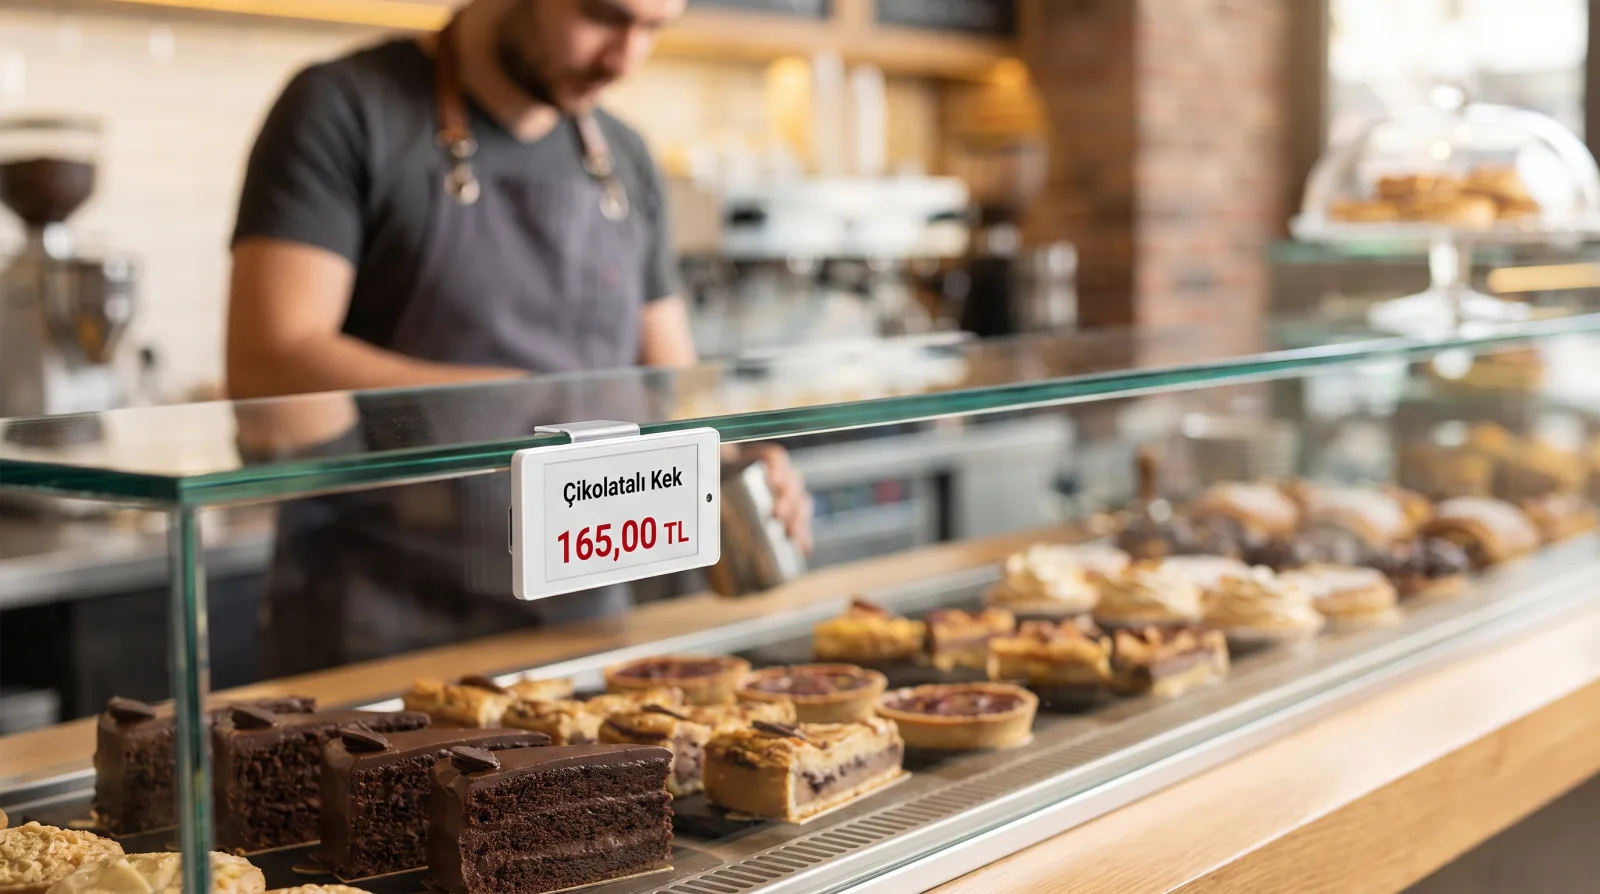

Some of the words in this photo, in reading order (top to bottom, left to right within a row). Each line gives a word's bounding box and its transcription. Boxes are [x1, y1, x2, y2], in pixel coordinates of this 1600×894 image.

[563, 472, 646, 508] Çikolatalı
[651, 466, 683, 490] Kek
[557, 516, 657, 564] 165,00
[664, 520, 689, 545] TL
